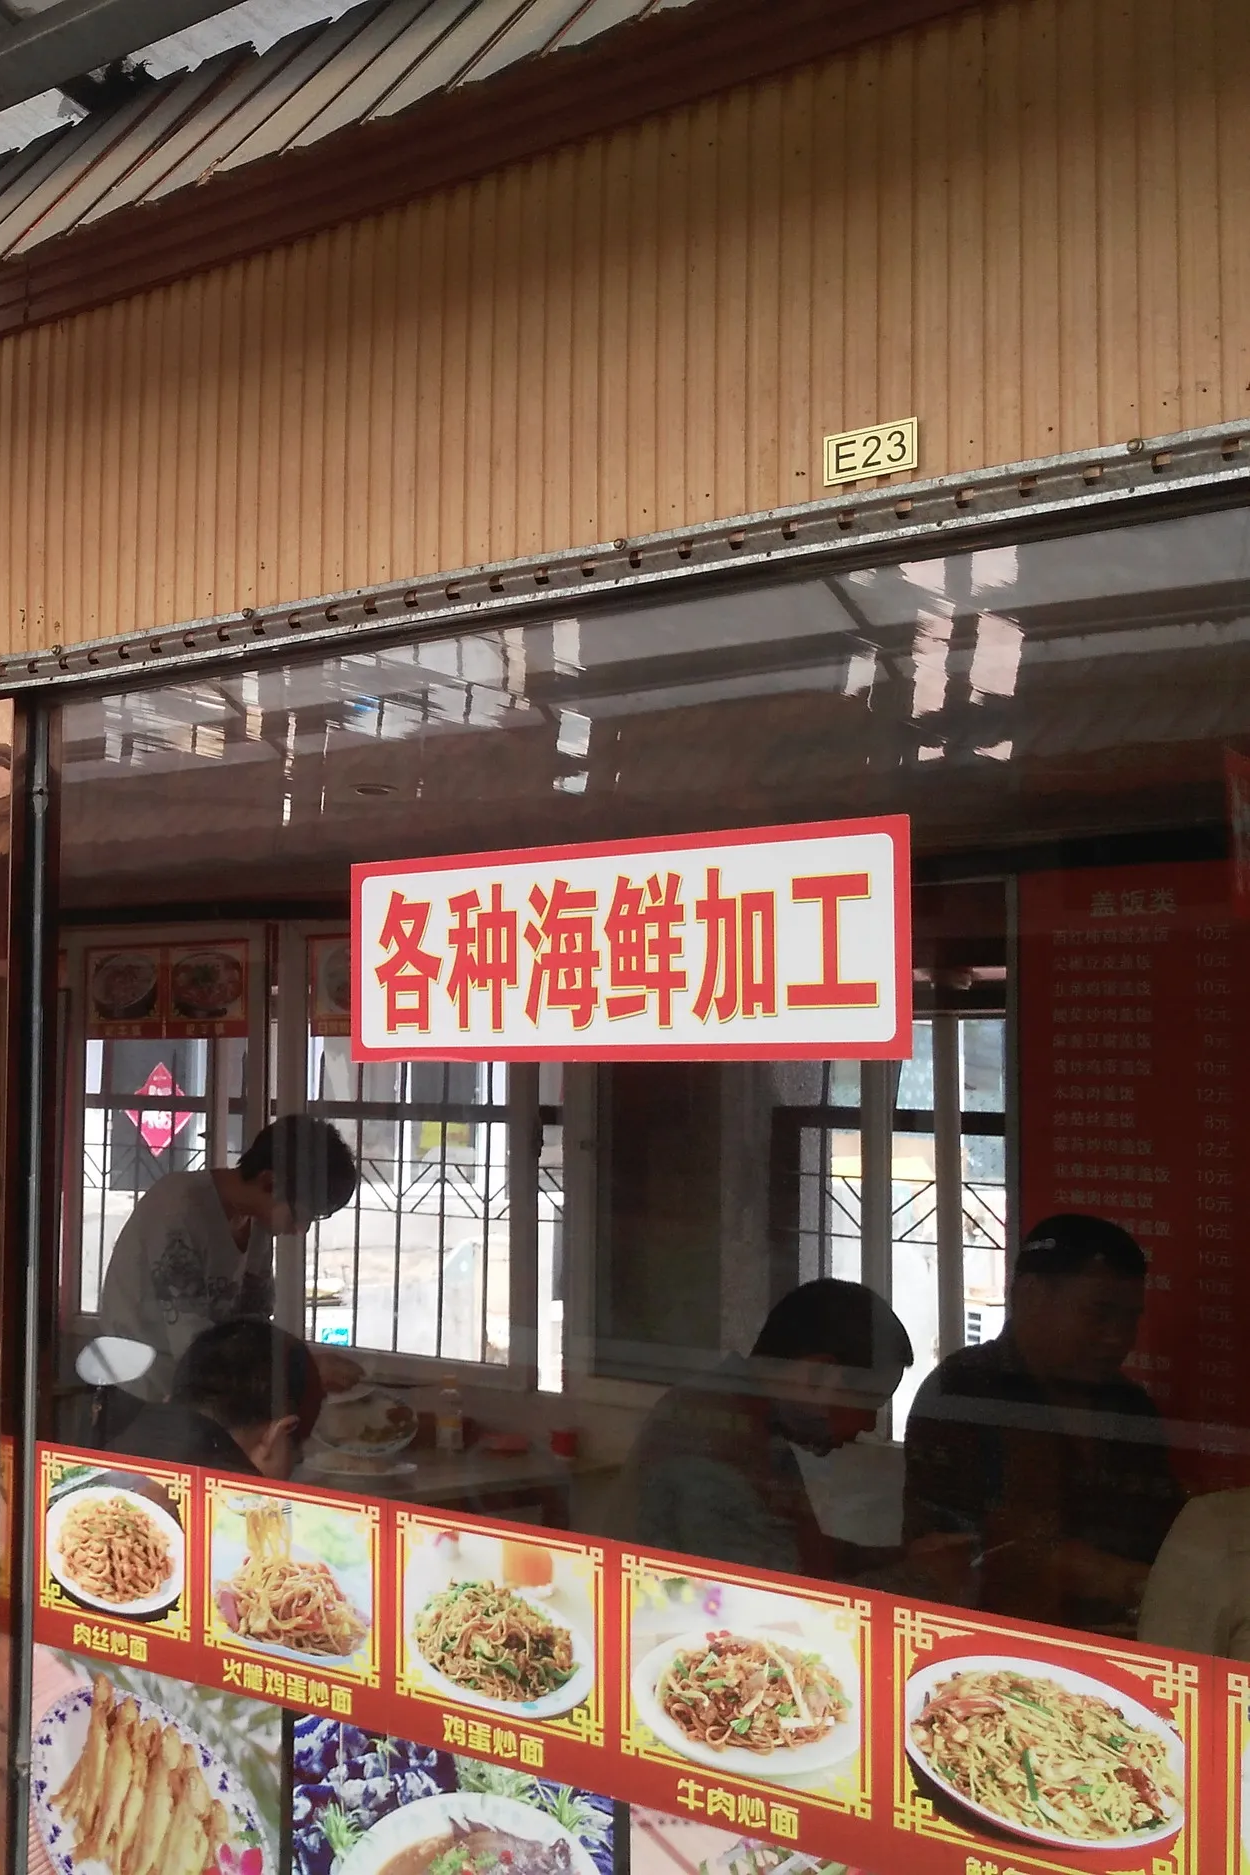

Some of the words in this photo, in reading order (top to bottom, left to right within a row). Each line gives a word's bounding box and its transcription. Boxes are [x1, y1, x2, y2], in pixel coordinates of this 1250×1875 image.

[835, 430, 907, 474] E23
[1089, 886, 1177, 918] 盖饭类
[374, 866, 880, 1034] 各种海鲜加工
[73, 1622, 148, 1663] 肉丝炒面
[222, 1658, 353, 1716] 火腿鸡蛋炒面
[442, 1713, 545, 1769] 鸡蛋炒面
[676, 1777, 800, 1841] 牛肉炒面
